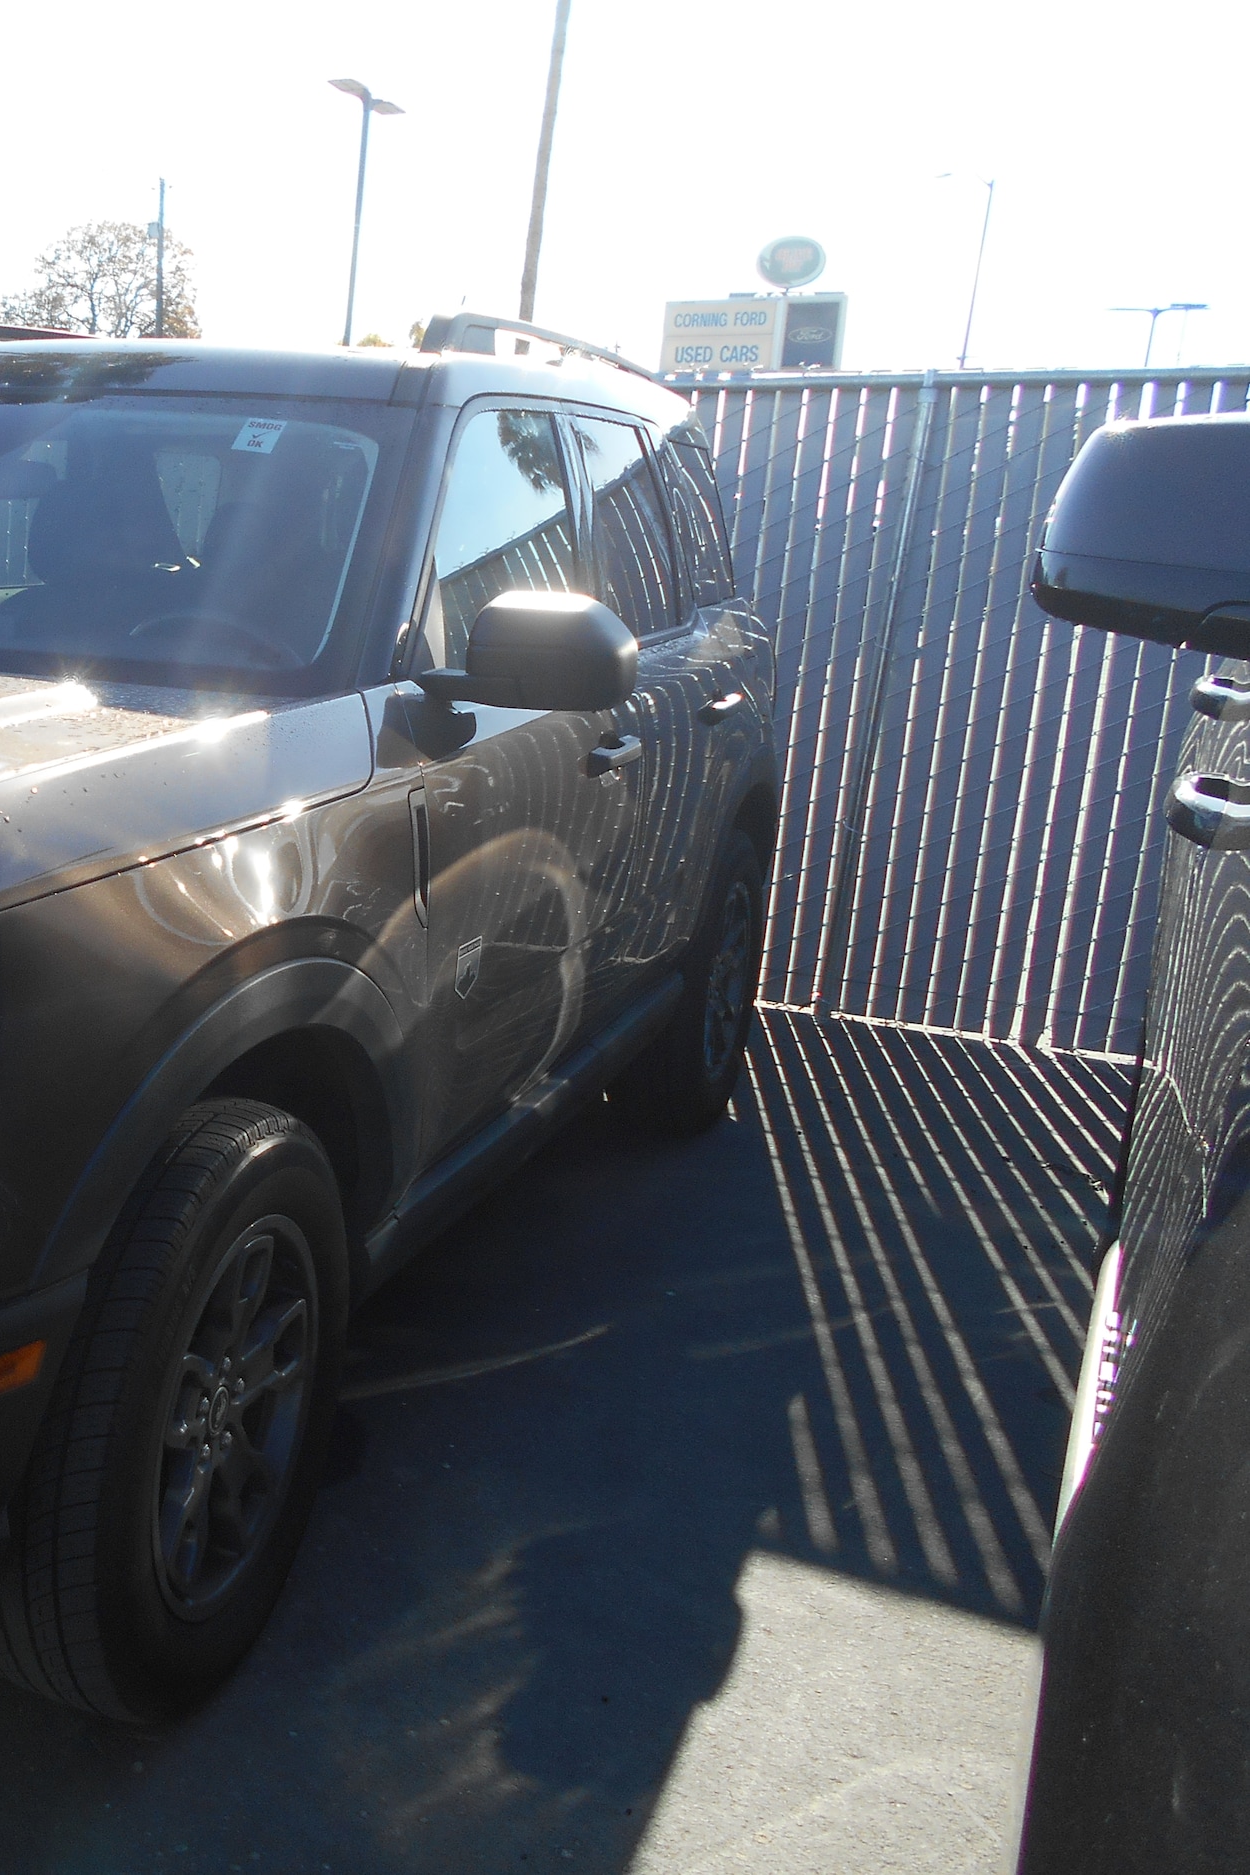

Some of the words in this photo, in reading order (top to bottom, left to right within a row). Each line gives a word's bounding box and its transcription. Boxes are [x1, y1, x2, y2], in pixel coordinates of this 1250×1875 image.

[674, 312, 727, 328] CORNING
[734, 311, 767, 327] FORD
[674, 346, 713, 363] USED
[720, 345, 759, 362] CARS
[248, 421, 283, 431] SMOG
[247, 440, 263, 448] OK
